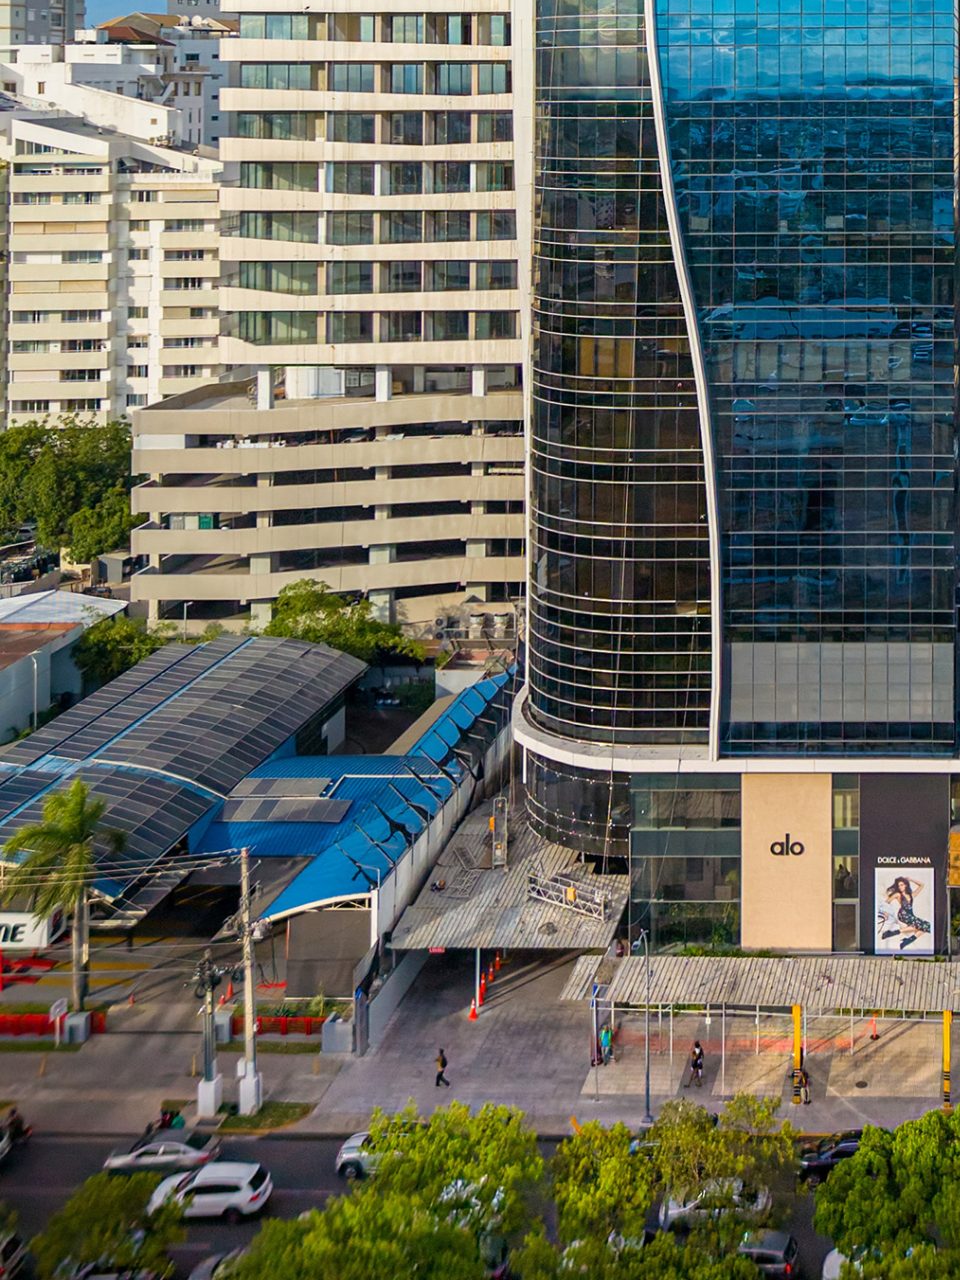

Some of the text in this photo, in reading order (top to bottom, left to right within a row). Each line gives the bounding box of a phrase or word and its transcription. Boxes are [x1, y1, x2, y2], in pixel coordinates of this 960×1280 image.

[770, 833, 805, 856] alo
[878, 856, 896, 864] DOLCE
[900, 856, 931, 864] GABBANA
